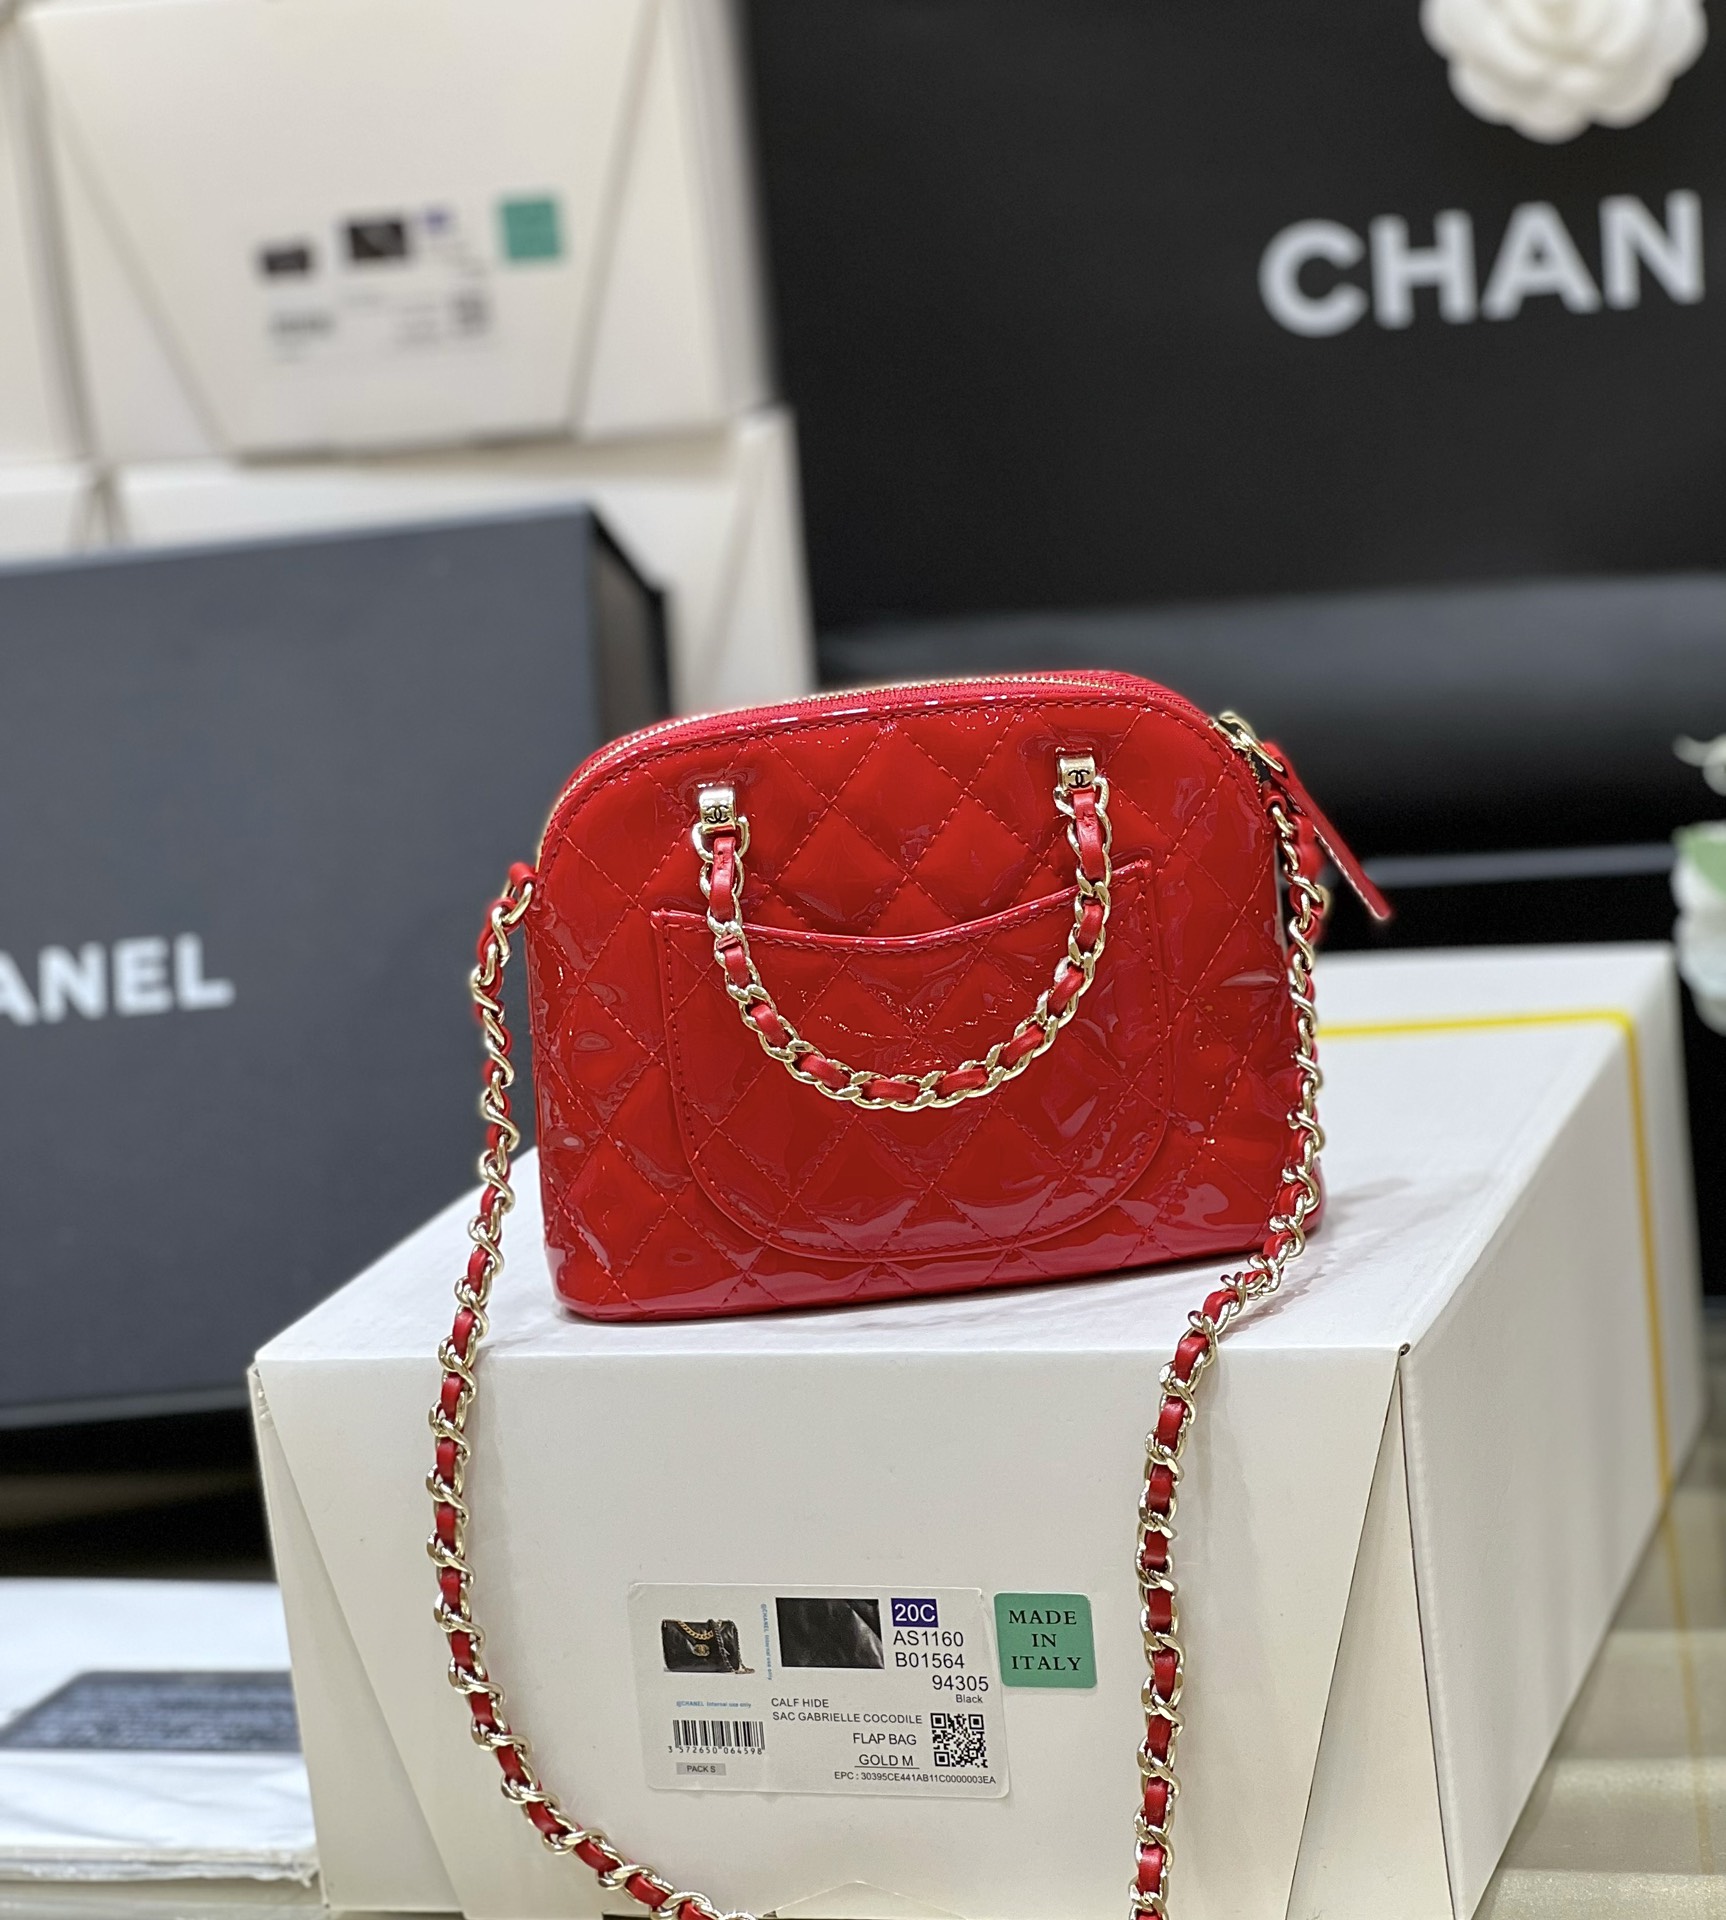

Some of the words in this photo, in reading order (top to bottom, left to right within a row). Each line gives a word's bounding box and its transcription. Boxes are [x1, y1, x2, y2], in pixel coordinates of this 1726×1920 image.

[1258, 188, 1705, 338] CHAN
[894, 1603, 936, 1622] 20C
[1008, 1609, 1077, 1625] MADE
[893, 1630, 964, 1647] AS1160
[1031, 1633, 1057, 1648] IN
[895, 1652, 965, 1669] B01564
[1011, 1655, 1082, 1671] ITALY
[932, 1675, 989, 1692] 94305
[771, 1698, 799, 1708] CALF
[802, 1698, 829, 1708] HIDE
[955, 1694, 984, 1704] Black
[772, 1711, 796, 1721] SAC
[798, 1712, 861, 1723] GABRIELLE
[863, 1713, 923, 1724] COCODILE
[853, 1733, 886, 1745] FLAP
[888, 1734, 917, 1746] BAG
[859, 1754, 899, 1767] GOLD
[902, 1755, 914, 1767] M
[686, 1765, 709, 1773] PACK
[710, 1765, 716, 1774] S
[834, 1771, 854, 1781] EPC
